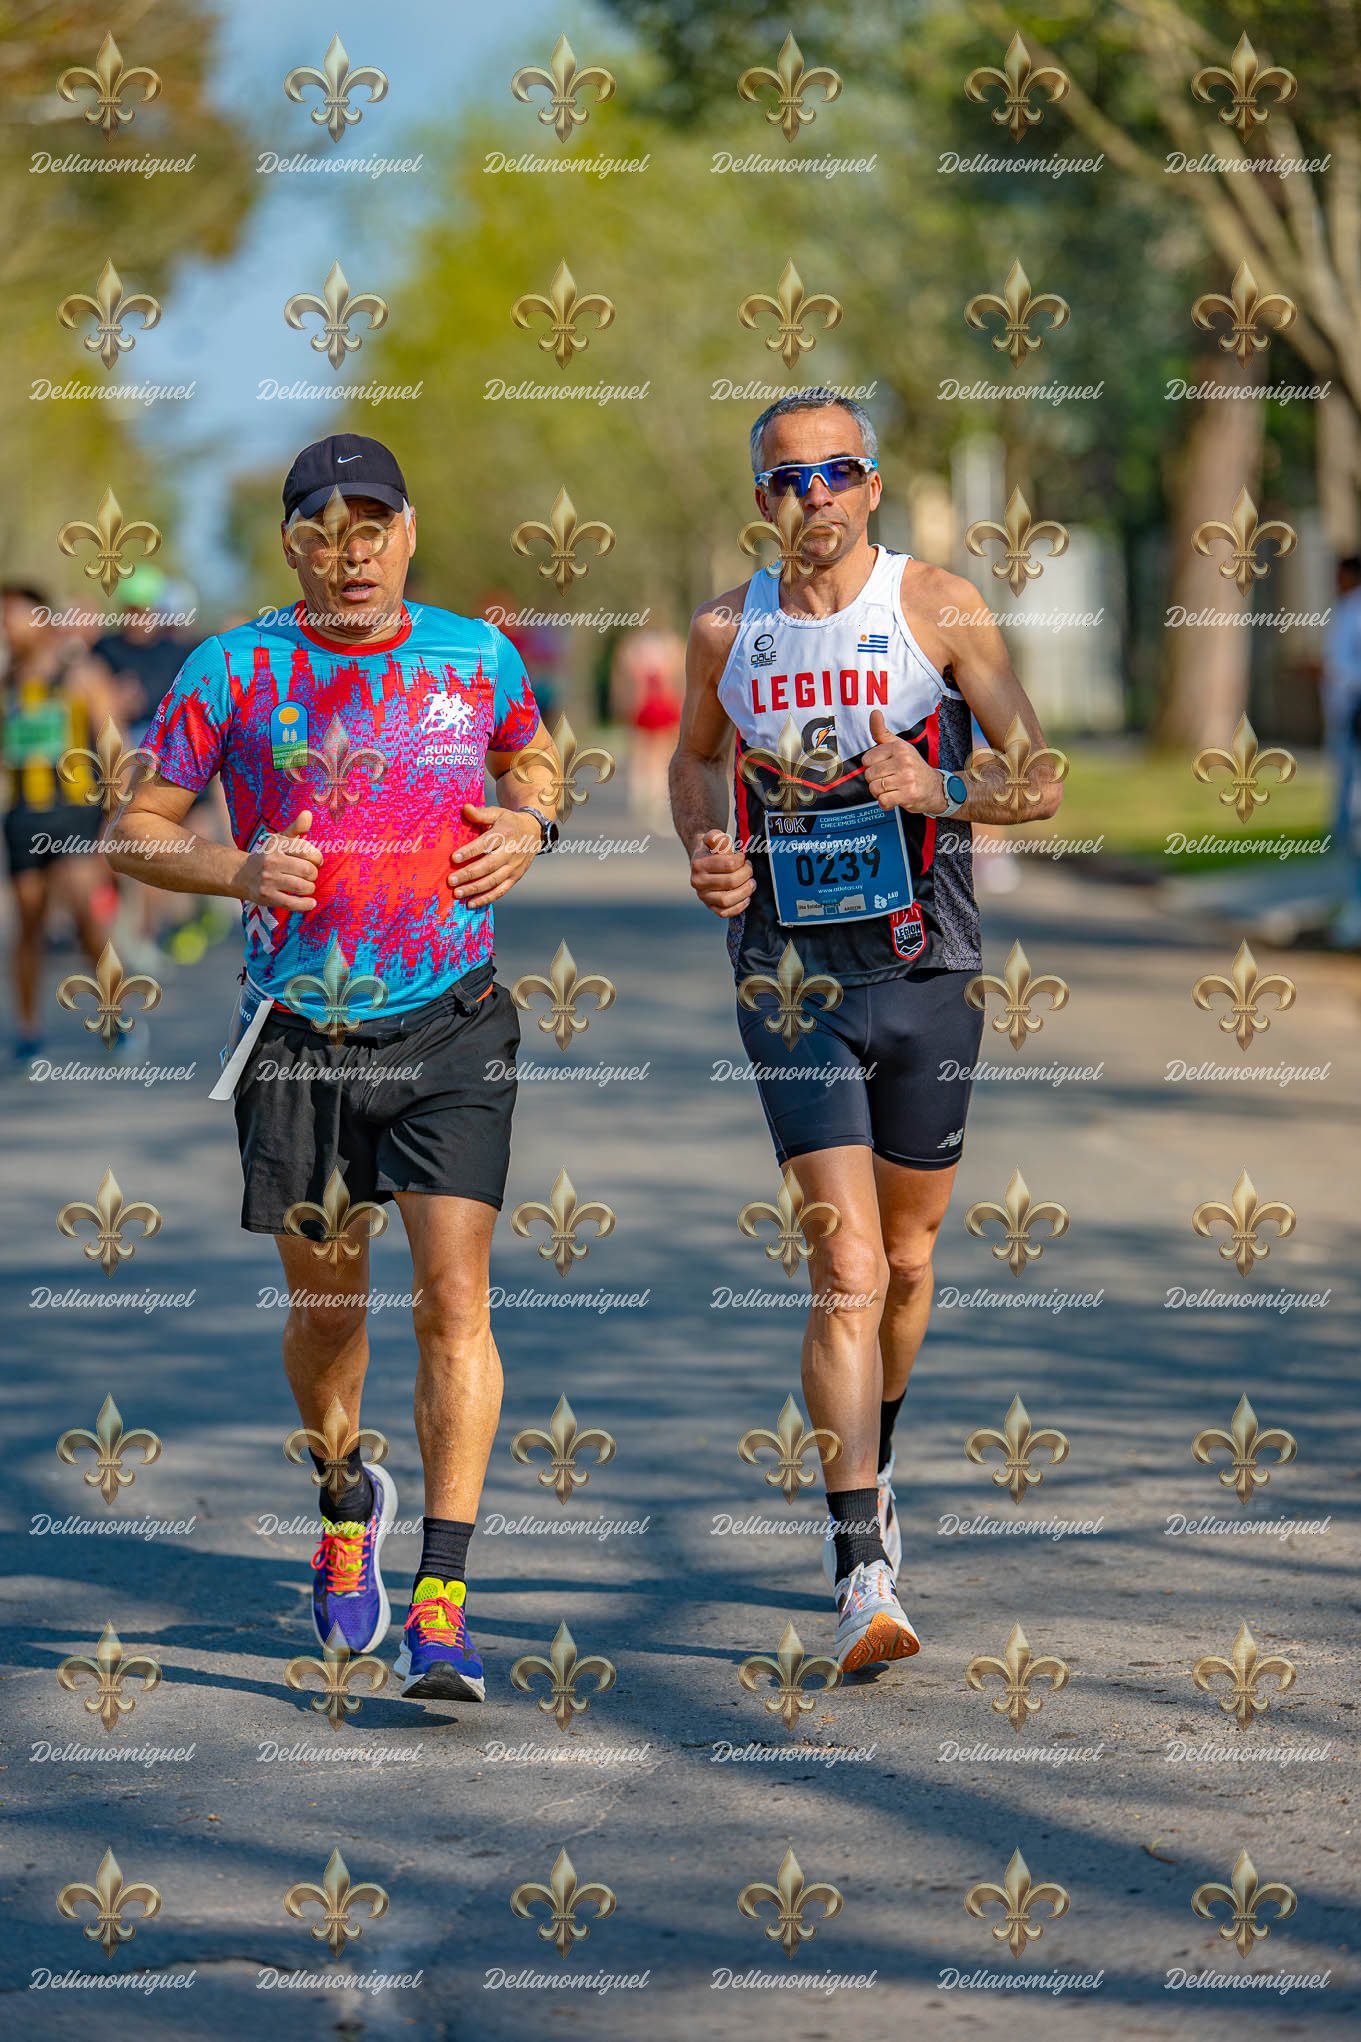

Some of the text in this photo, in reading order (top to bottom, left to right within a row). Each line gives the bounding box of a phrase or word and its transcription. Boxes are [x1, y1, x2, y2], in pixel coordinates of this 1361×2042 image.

[751, 669, 889, 715] LEGION
[424, 743, 478, 756] RUNNING
[416, 754, 479, 767] PROGRESO
[774, 816, 808, 834] 10K
[795, 846, 881, 887] 0239
[895, 922, 922, 938] LEGION
